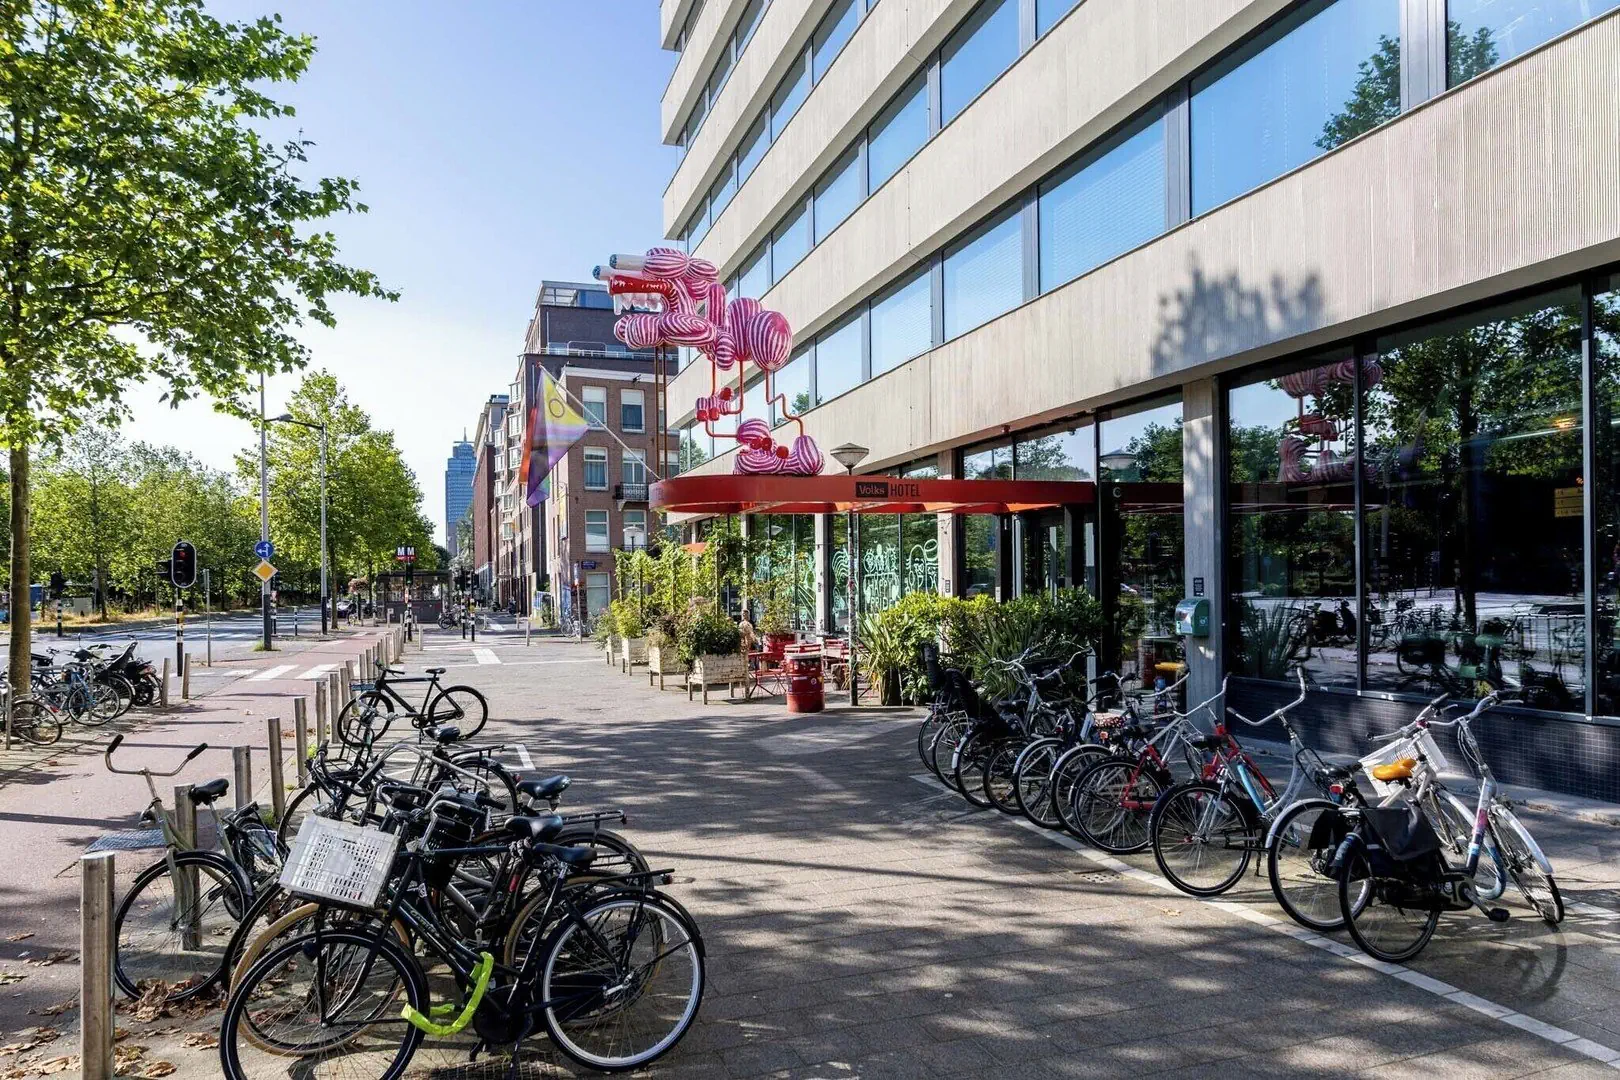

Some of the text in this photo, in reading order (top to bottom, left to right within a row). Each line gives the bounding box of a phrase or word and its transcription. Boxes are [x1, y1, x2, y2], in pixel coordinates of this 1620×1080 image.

[858, 484, 921, 497] Volks HOTEL
[397, 546, 405, 556] M
[407, 546, 415, 556] M
[868, 578, 893, 599] HAPPY
